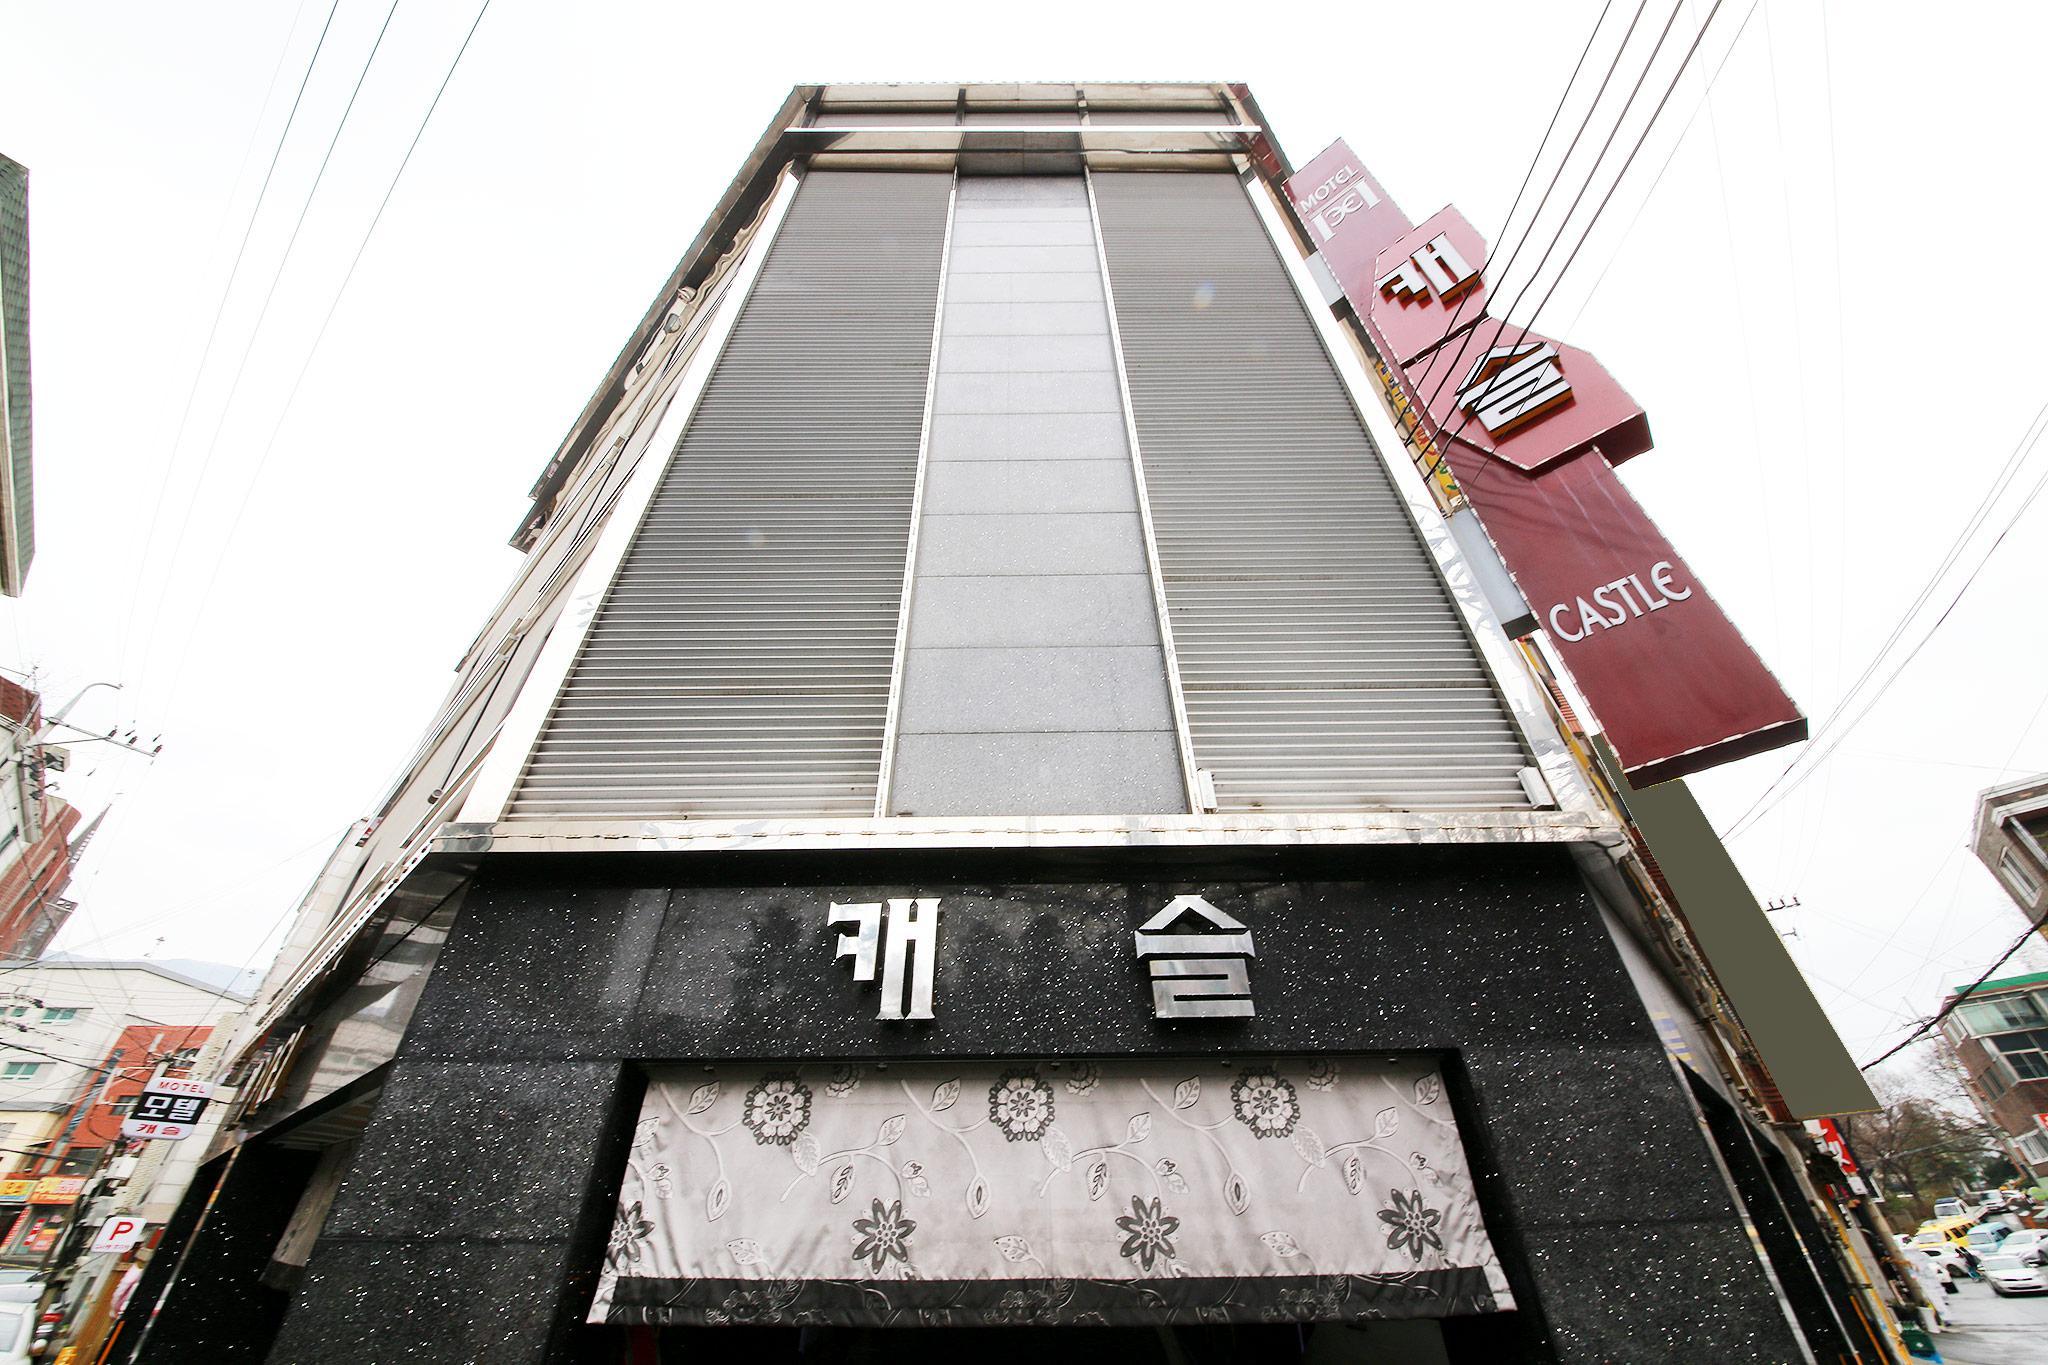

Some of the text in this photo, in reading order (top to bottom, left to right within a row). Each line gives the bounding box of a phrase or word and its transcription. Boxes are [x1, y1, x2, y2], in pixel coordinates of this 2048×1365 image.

[1299, 164, 1360, 214] MOTEL
[1548, 560, 1693, 643] CASTLE
[827, 894, 1257, 1020] 캐슬
[156, 1081, 207, 1094] MOTEL
[137, 1095, 202, 1121] 모텔
[108, 1220, 135, 1241] P
